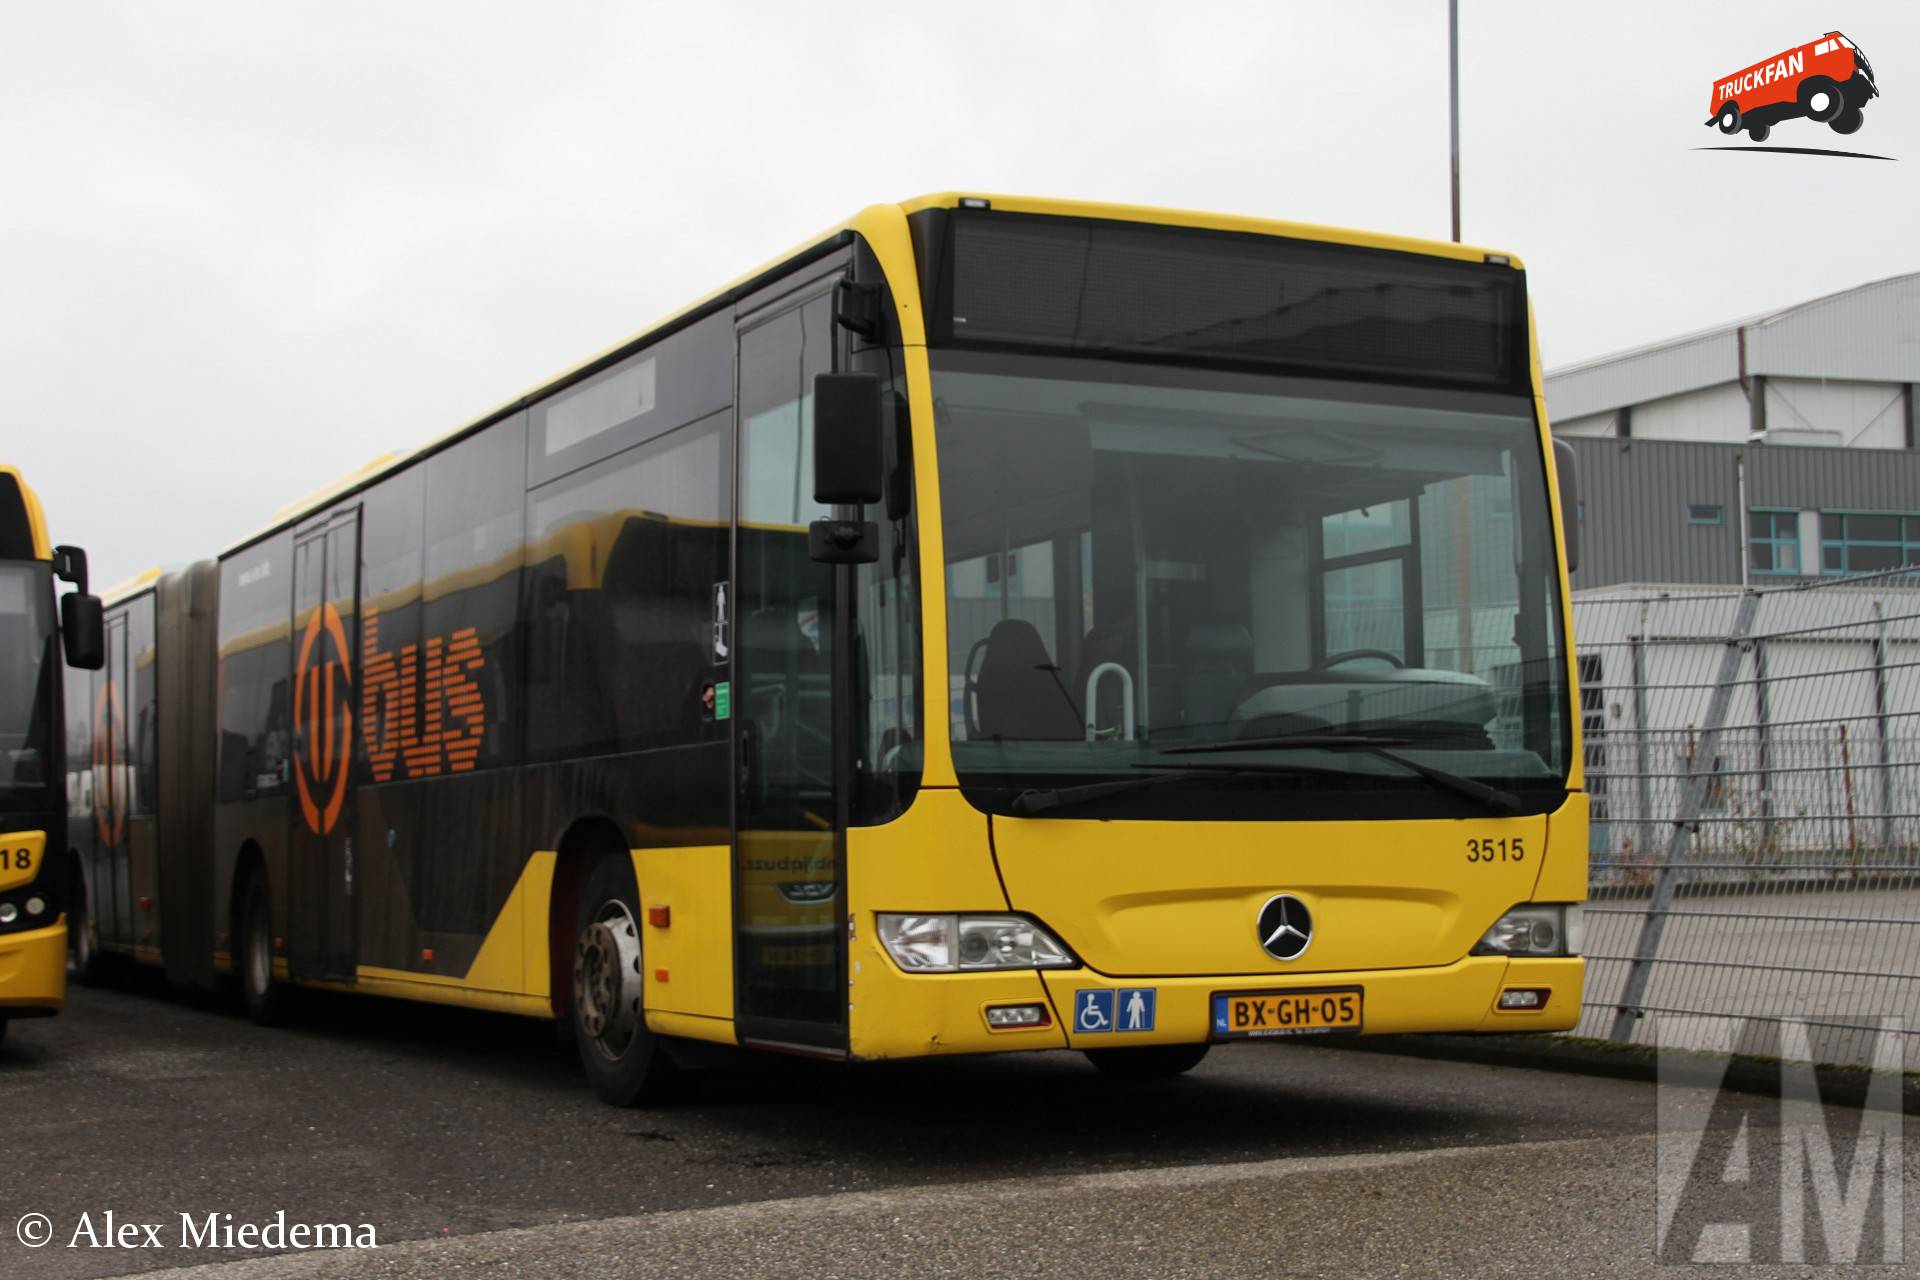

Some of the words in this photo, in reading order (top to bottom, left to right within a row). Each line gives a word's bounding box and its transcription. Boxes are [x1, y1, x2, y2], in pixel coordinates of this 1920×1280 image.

[363, 607, 485, 782] bus
[0, 847, 31, 870] 18
[1467, 838, 1524, 862] 3515
[1216, 1018, 1227, 1028] NL
[1234, 997, 1354, 1027] BX-GH-05
